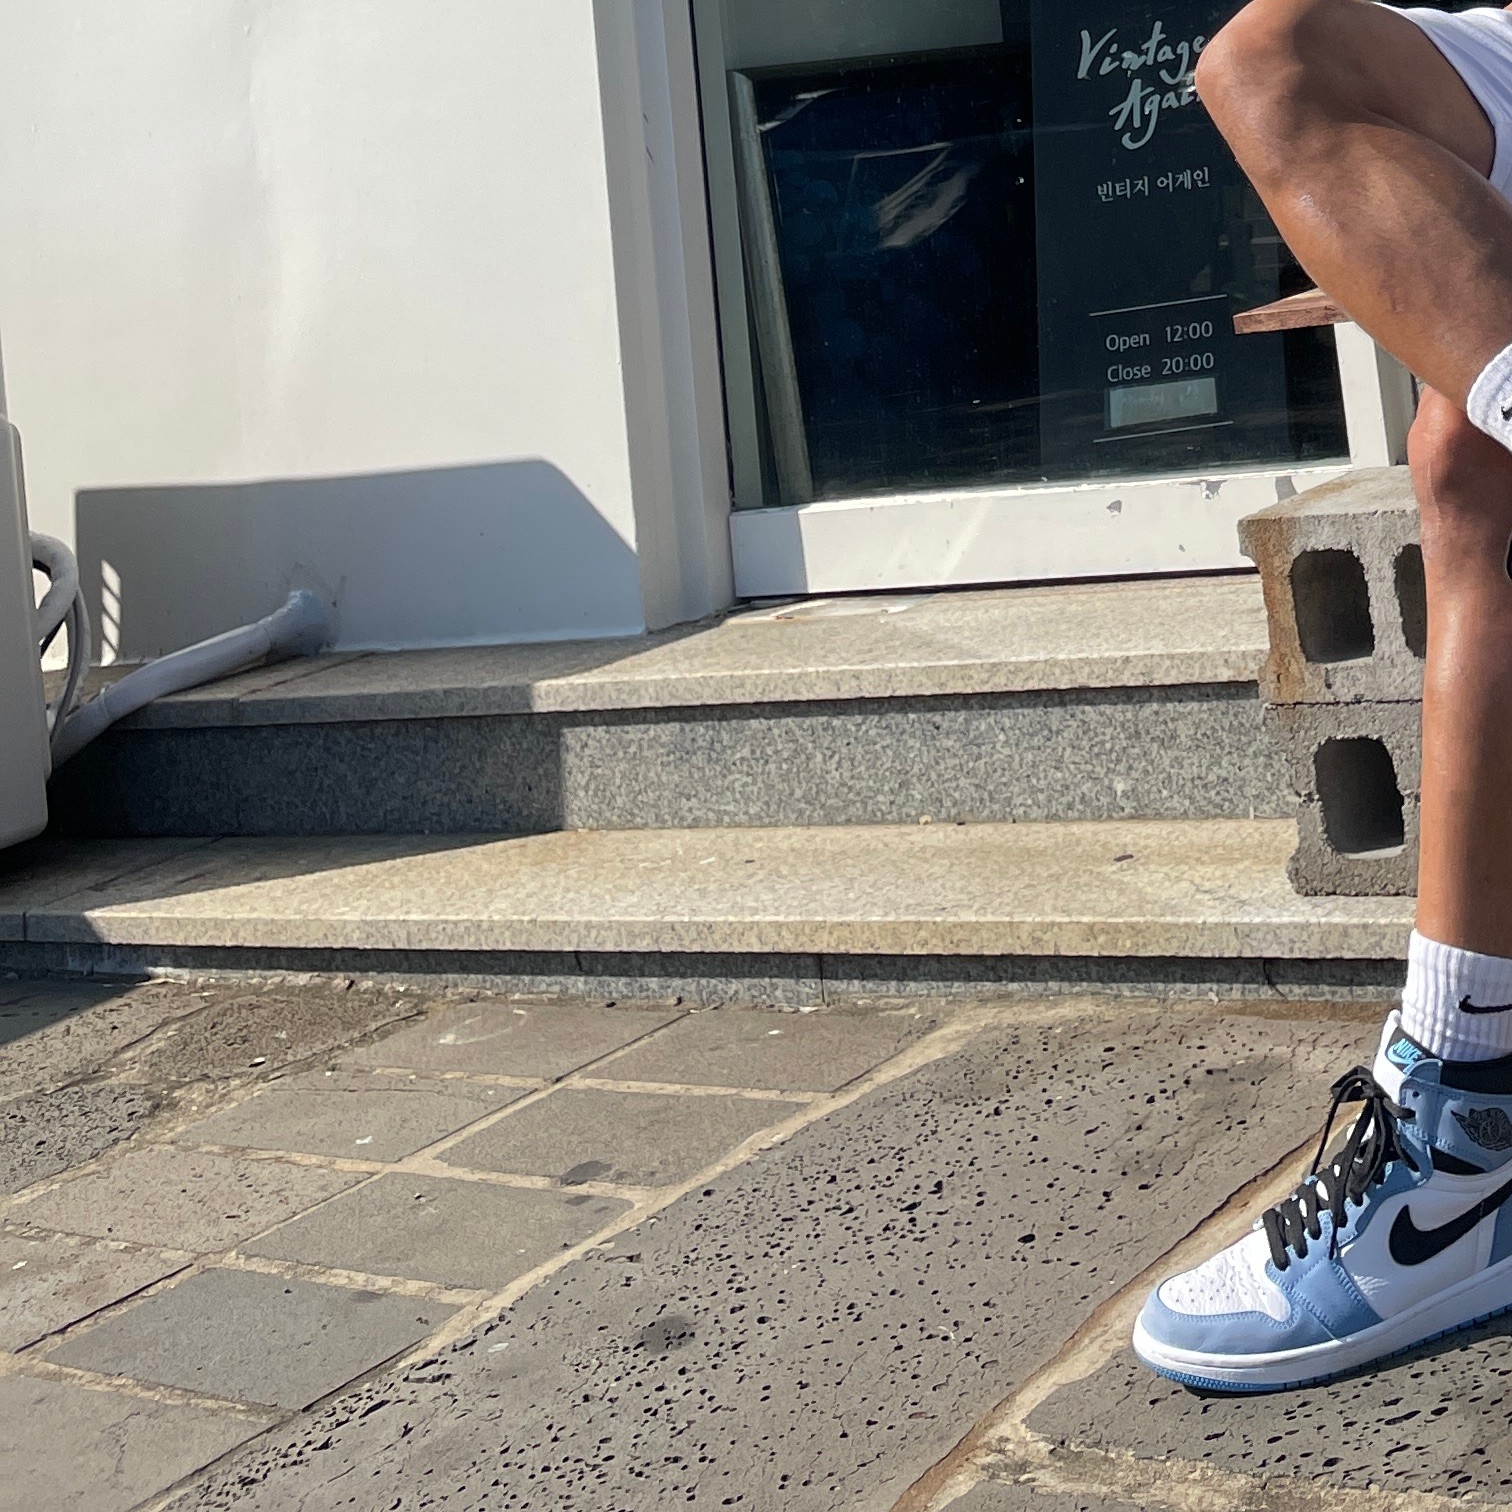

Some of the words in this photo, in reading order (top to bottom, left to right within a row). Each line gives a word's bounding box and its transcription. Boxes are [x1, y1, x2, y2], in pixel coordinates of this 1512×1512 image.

[1077, 20, 1206, 86] Vintage
[1108, 78, 1201, 150] Agai
[1097, 175, 1149, 202] 빈티지
[1156, 166, 1211, 193] 어게인
[1105, 333, 1150, 353] Open
[1165, 321, 1213, 343] 12:00
[1107, 364, 1152, 383] Close
[1161, 352, 1215, 376] 20:00
